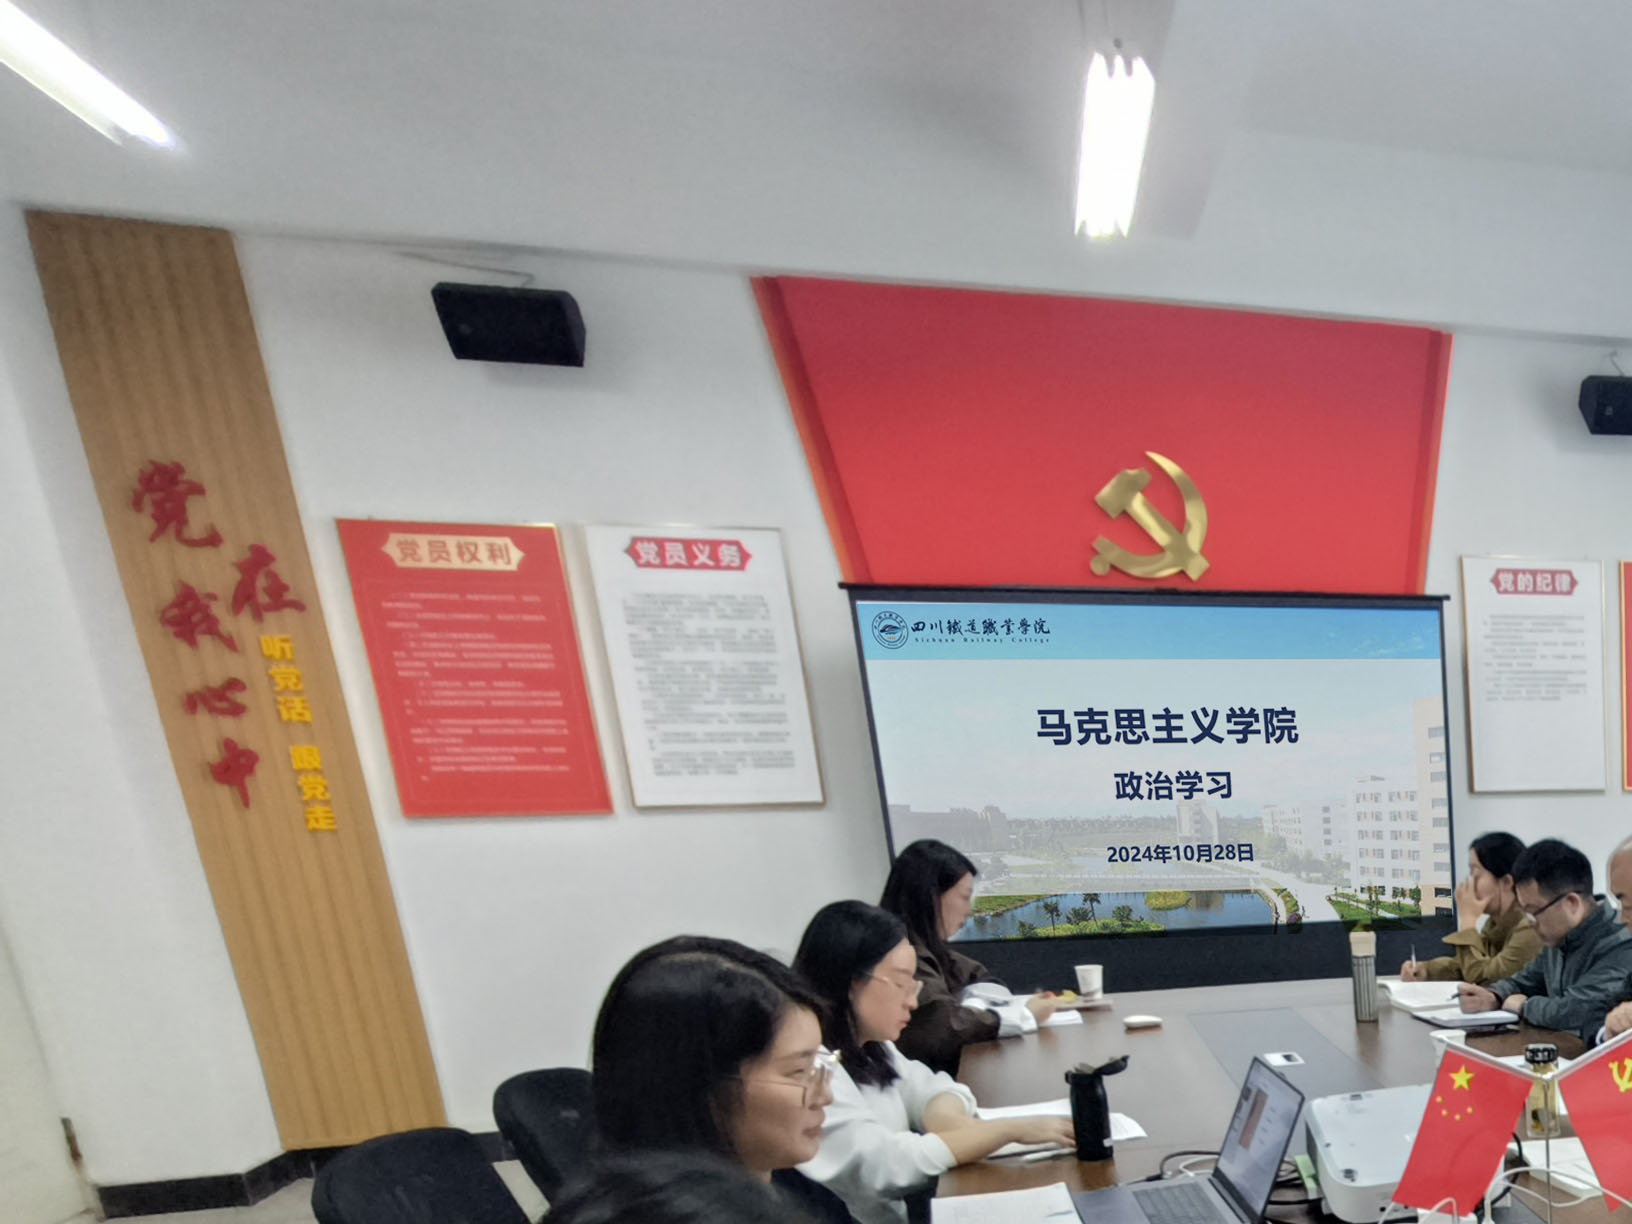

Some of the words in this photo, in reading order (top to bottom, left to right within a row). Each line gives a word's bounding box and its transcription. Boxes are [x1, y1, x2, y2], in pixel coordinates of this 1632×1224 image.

[396, 539, 512, 566] 党员权利
[634, 540, 742, 568] 党员义务
[1498, 572, 1572, 593] 党的纪律
[259, 634, 313, 723] 听党话
[289, 745, 337, 832] 跟党走
[1036, 707, 1299, 746] 马克思主义学院
[1114, 770, 1233, 801] 政治学习
[1107, 843, 1255, 863] 2024年10月28日
